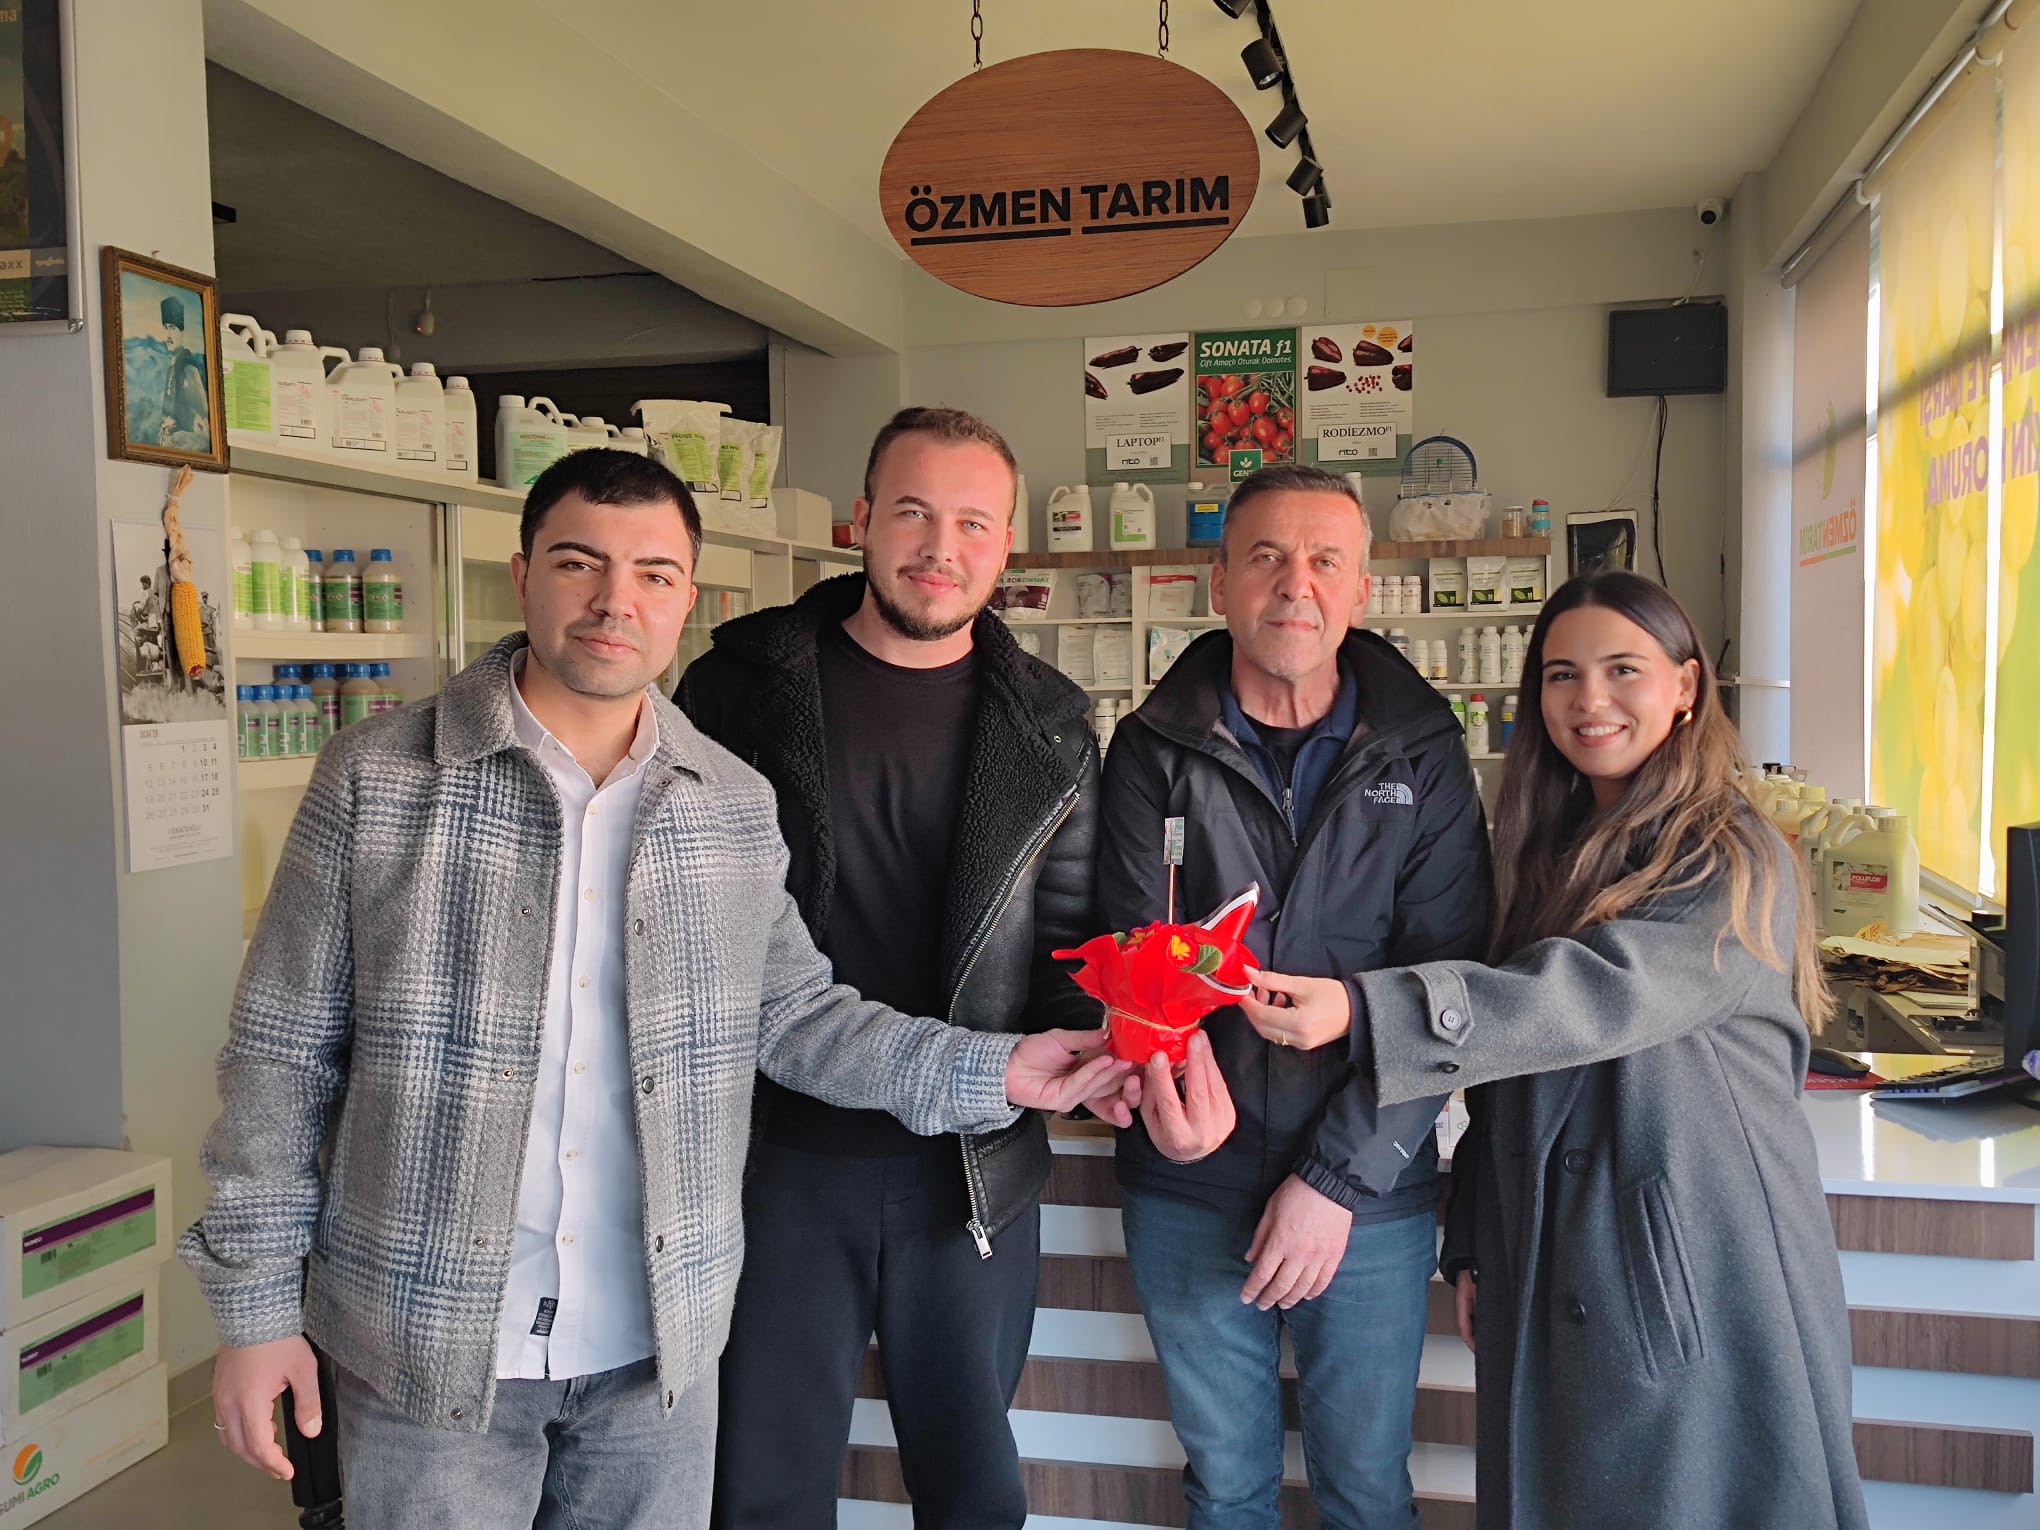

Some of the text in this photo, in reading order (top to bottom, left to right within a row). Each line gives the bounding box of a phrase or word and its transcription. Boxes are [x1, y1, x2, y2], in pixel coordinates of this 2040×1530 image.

[904, 175, 1230, 233] ÖZMEN TARIM
[1200, 339, 1292, 358] SONATA f1
[1237, 357, 1260, 366] Oturak
[1261, 356, 1291, 365] Domates
[1323, 426, 1386, 438] RODİEZMO
[1116, 437, 1159, 448] LAPTOP
[200, 757, 208, 768] 10
[211, 757, 217, 766] 11
[201, 772, 209, 781] 17
[1377, 782, 1397, 790] THE
[201, 788, 209, 797] 24
[1364, 788, 1397, 797] NORTH
[1373, 796, 1397, 804] FACE
[26, 1472, 60, 1501] AGRO
